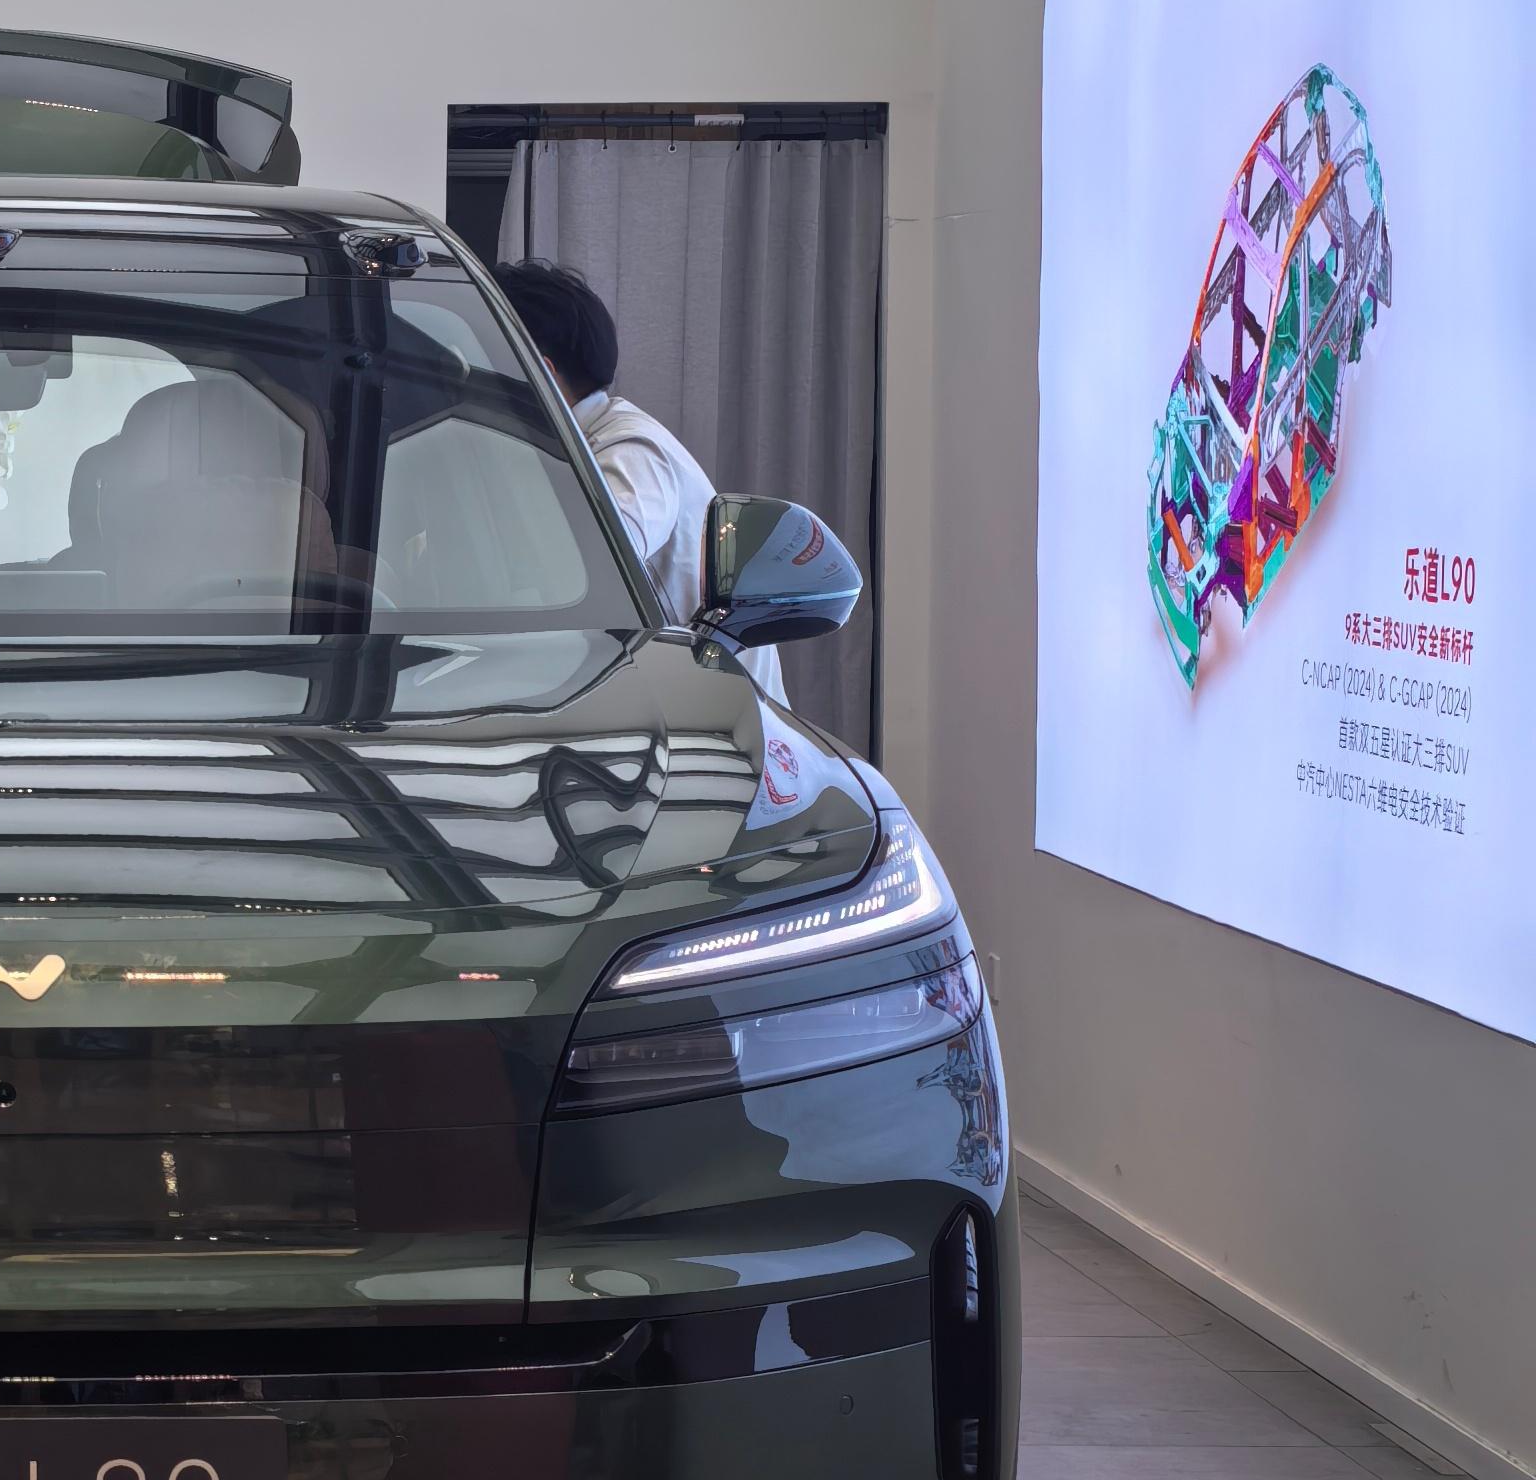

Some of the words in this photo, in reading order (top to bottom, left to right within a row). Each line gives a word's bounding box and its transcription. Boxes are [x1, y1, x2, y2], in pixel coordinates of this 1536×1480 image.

[1404, 546, 1476, 604] 乐道L90
[1345, 612, 1474, 666] 9系大三排SUV安全新标杆
[1301, 658, 1341, 691] C-NCAP
[1343, 662, 1375, 703] (2024)
[1389, 675, 1434, 710] C-GCAP
[1436, 680, 1472, 724] (2024)
